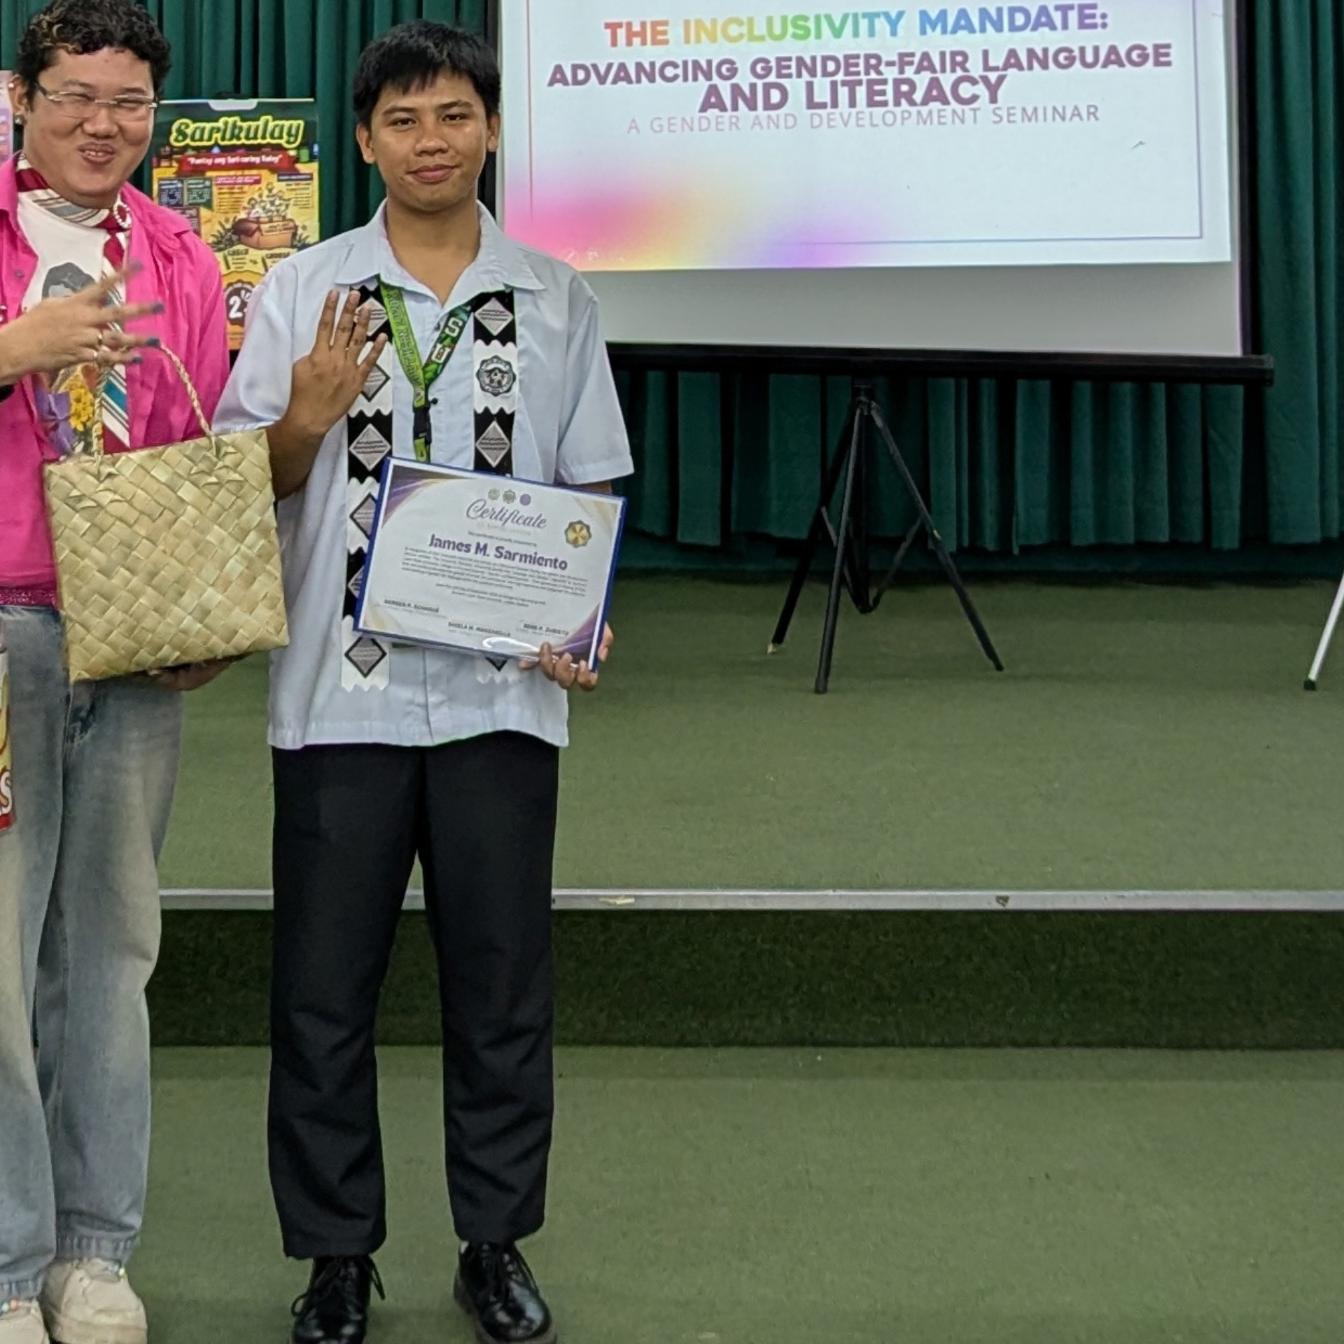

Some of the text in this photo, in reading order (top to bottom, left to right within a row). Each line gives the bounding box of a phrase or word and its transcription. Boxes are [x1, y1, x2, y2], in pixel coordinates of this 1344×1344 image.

[604, 3, 1109, 47] THE INCLUSIVITY MANDATE:
[547, 43, 1173, 87] ADVANCING GENDER-FAIR LANGUAGE
[698, 74, 1008, 113] AND LITERACY
[170, 116, 304, 147] Sarikulay
[627, 105, 1100, 134] A GENDER AND DEVELOPMENT SEMINAR
[465, 499, 548, 530] Certificate
[429, 534, 471, 554] James
[474, 542, 490, 557] M.
[494, 546, 568, 571] Sarmiento
